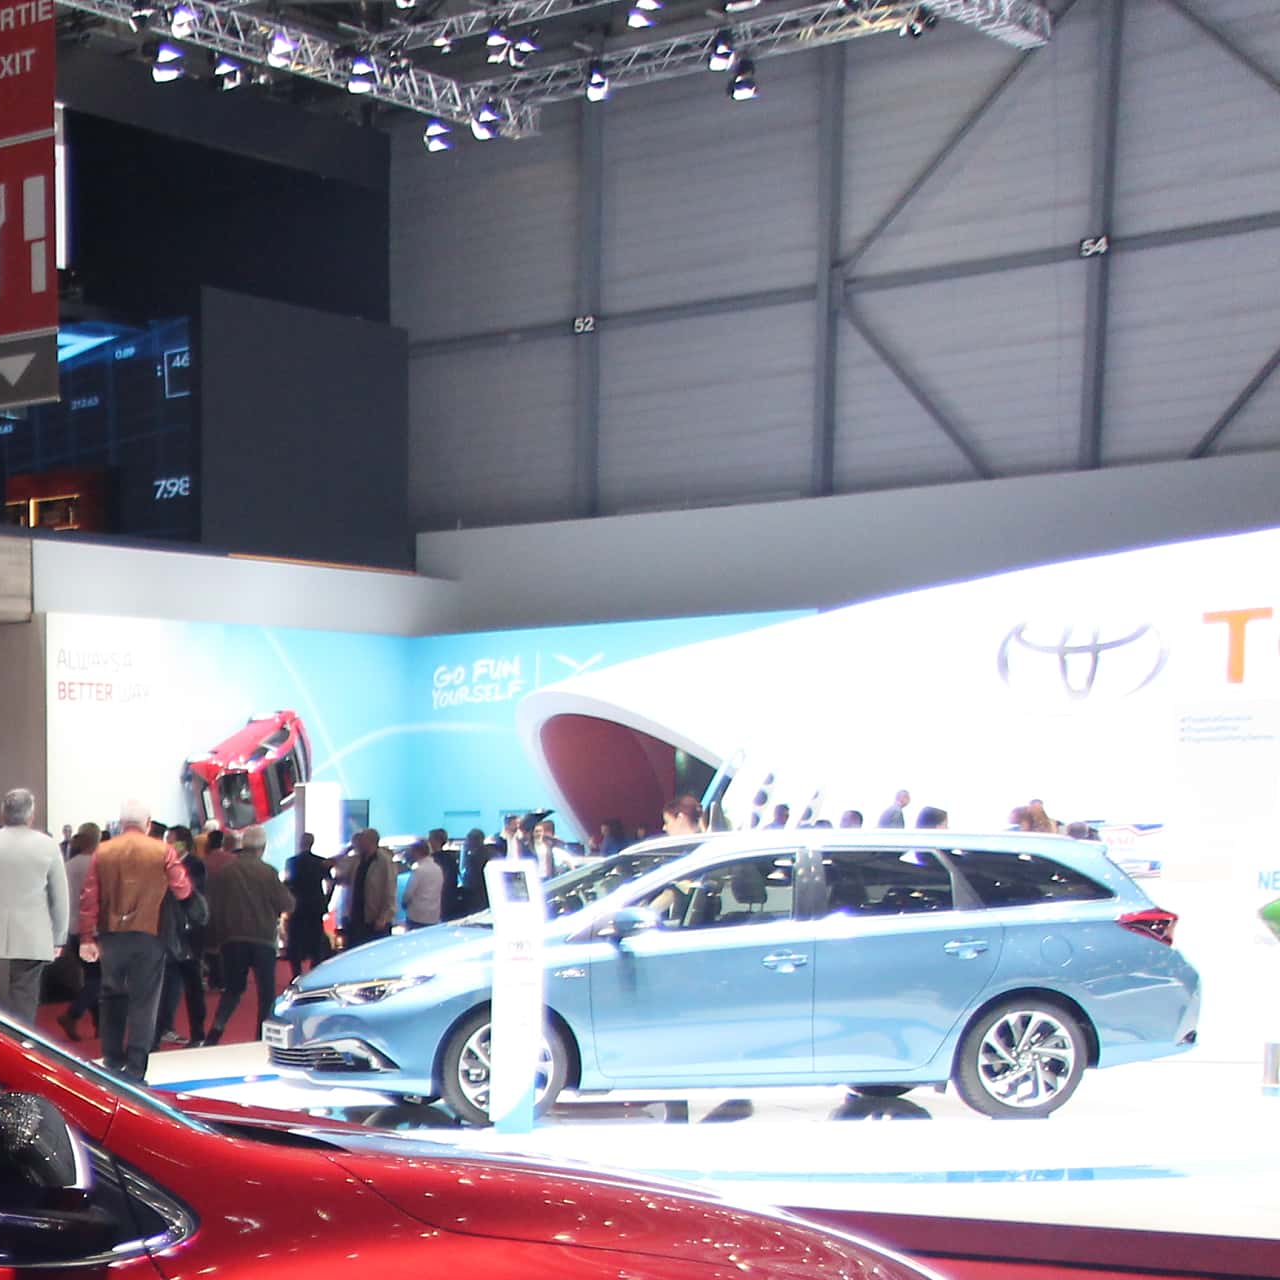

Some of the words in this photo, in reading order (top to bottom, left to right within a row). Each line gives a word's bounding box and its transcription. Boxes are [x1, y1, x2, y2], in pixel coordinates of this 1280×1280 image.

[1080, 235, 1109, 257] 54
[574, 316, 595, 333] 52
[432, 664, 466, 689] GO
[471, 655, 522, 684] FUN
[56, 681, 113, 701] BETTER
[431, 679, 529, 711] YOURSELF
